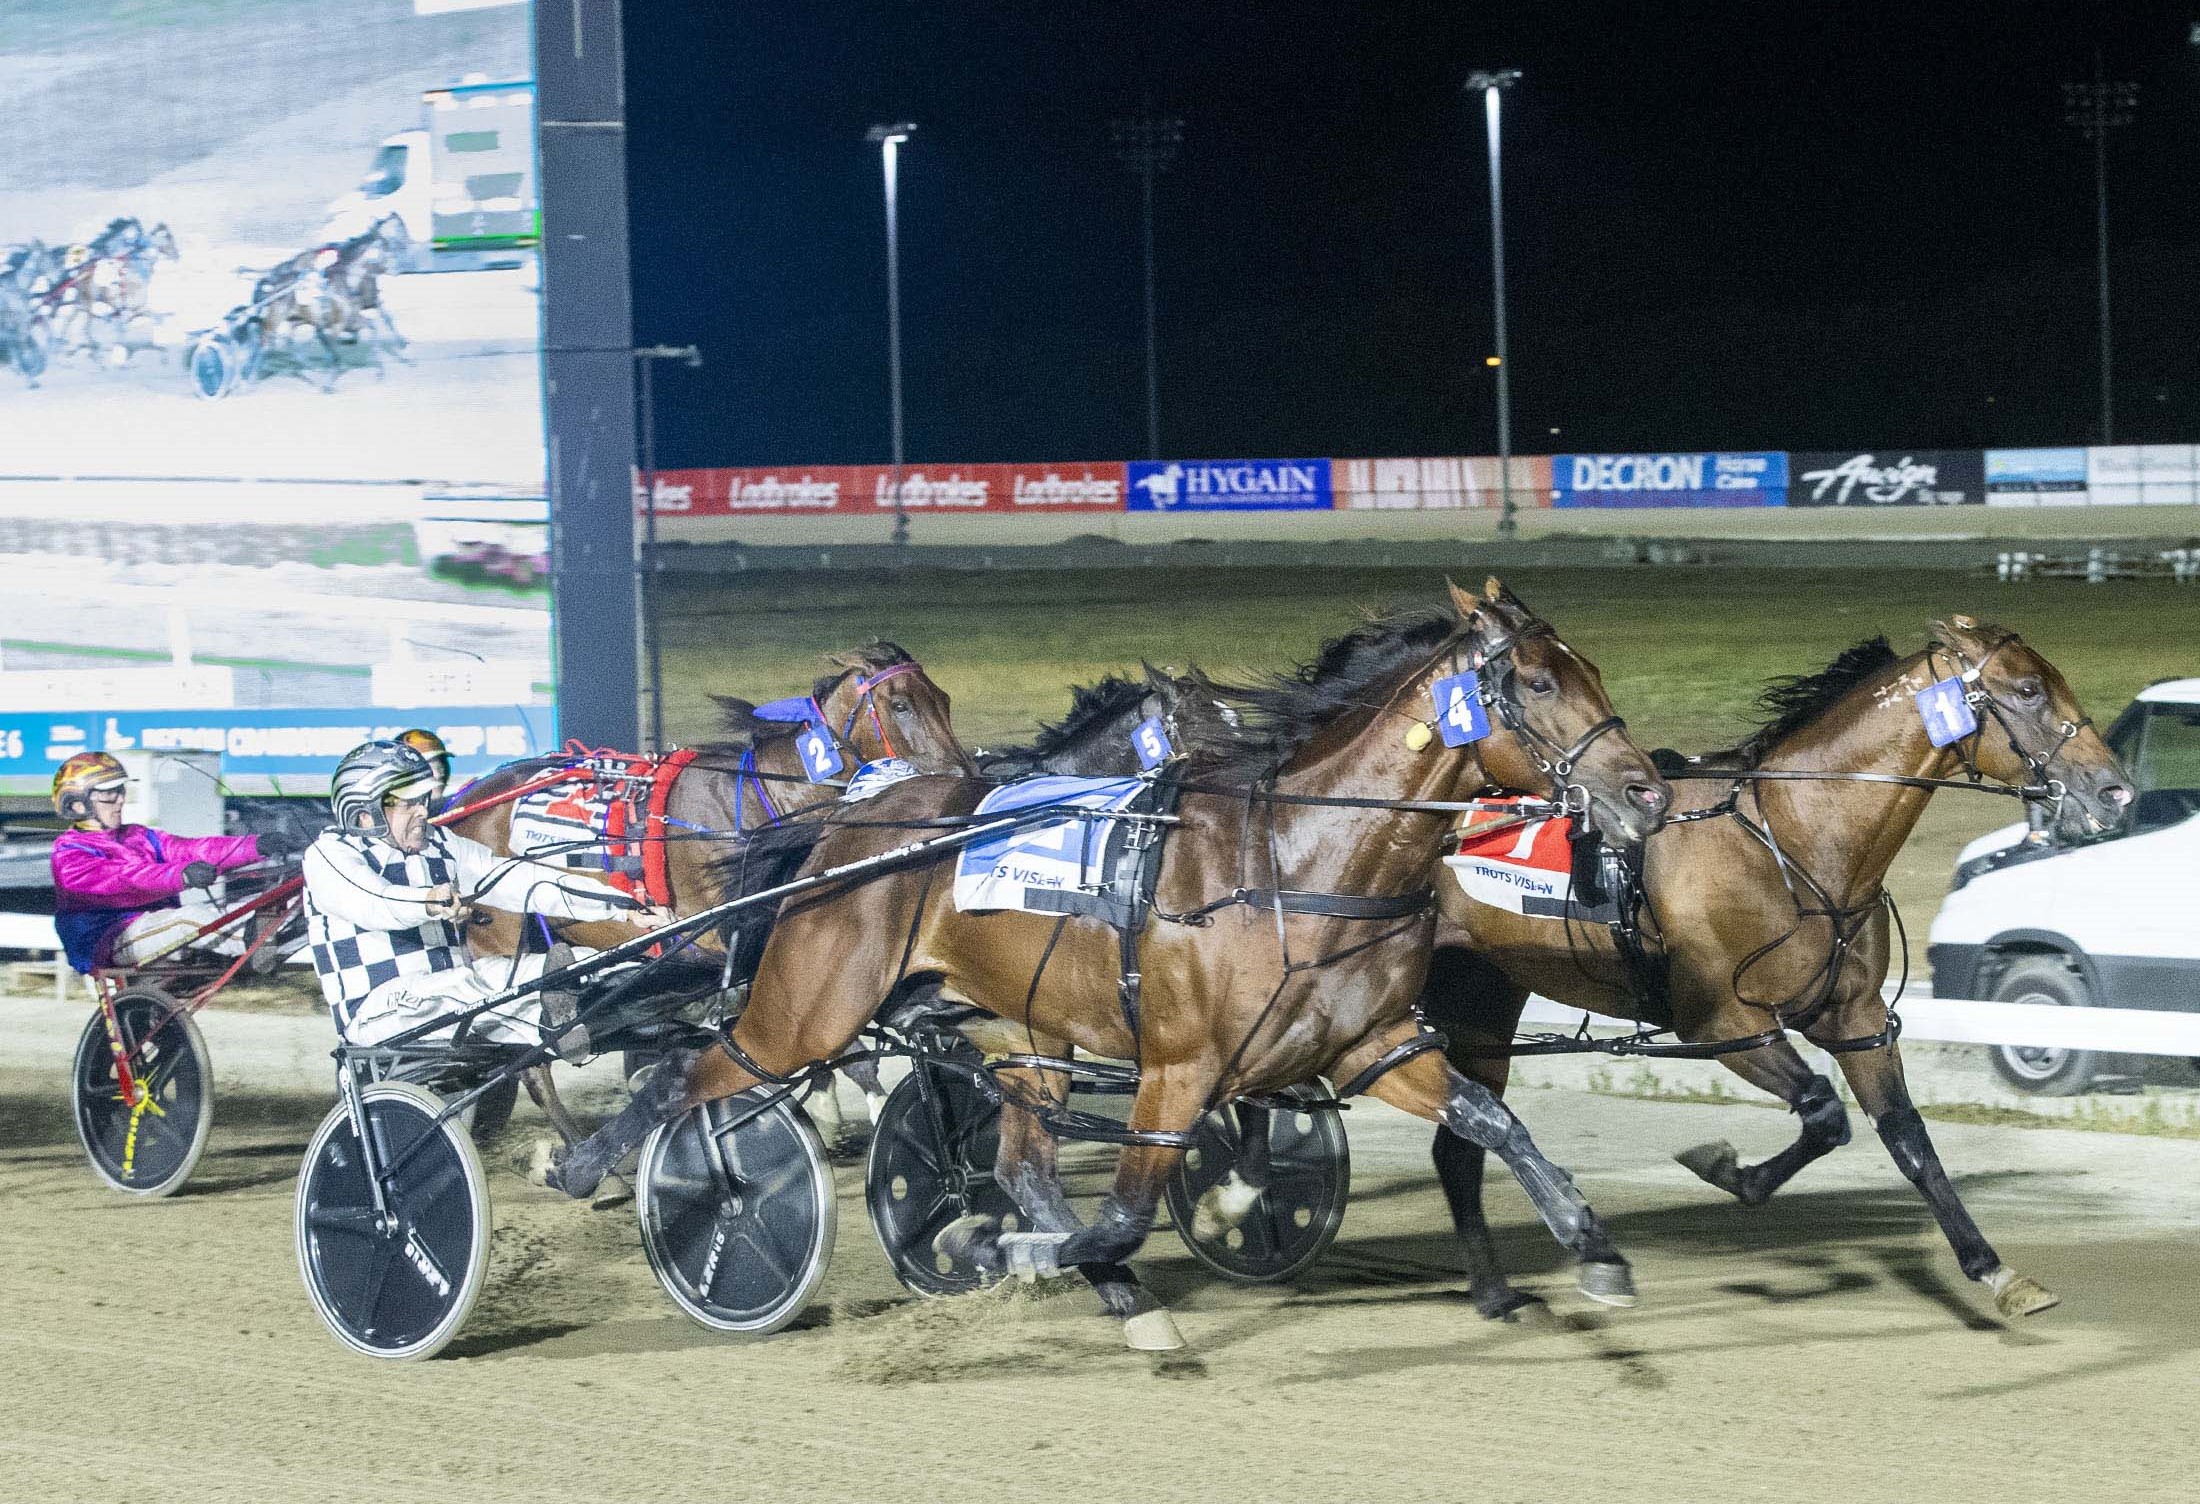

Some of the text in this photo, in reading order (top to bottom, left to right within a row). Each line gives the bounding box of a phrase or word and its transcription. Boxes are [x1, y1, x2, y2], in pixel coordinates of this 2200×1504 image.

[876, 473, 989, 507] Ladbrokes
[1014, 472, 1121, 504] Ladbrokes
[1186, 466, 1316, 493] HYGAIN
[1572, 456, 1704, 491] DECRON
[730, 474, 839, 509] Ladbrokes
[1448, 686, 1473, 733] 4
[1935, 691, 1961, 733] 1
[808, 737, 832, 773] 2
[1141, 727, 1162, 758] 5
[1475, 866, 1511, 884] TROTS
